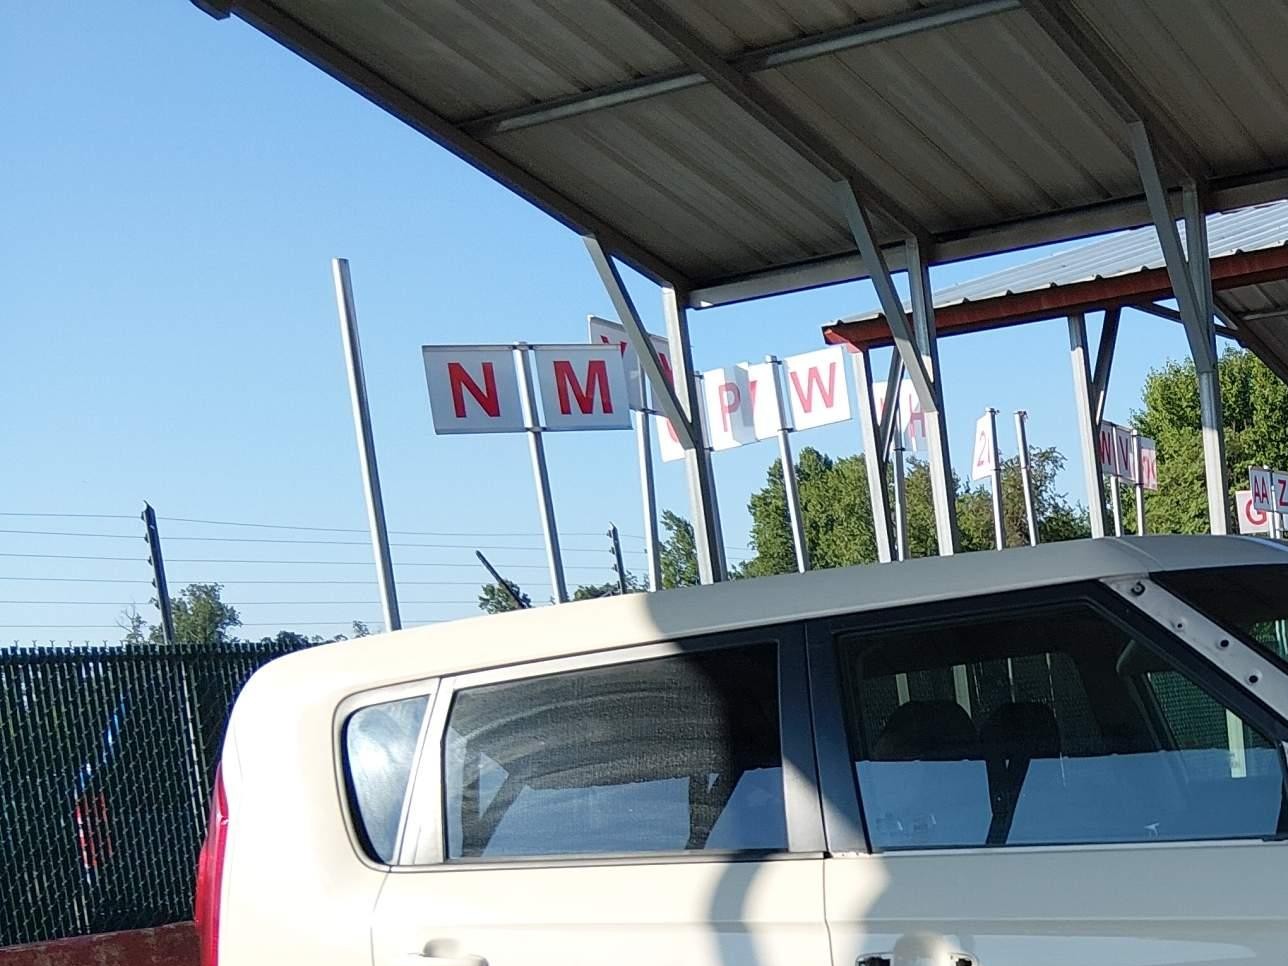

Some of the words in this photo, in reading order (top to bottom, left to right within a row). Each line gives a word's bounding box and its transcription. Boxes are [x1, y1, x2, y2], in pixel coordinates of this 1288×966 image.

[448, 362, 500, 418] N
[553, 360, 613, 415] M
[718, 382, 741, 432] P
[790, 362, 836, 413] W
[908, 393, 926, 438] H
[1119, 435, 1128, 470] V
[1245, 499, 1268, 525] G
[1254, 475, 1270, 504] AA
[1278, 479, 1288, 506] Z
